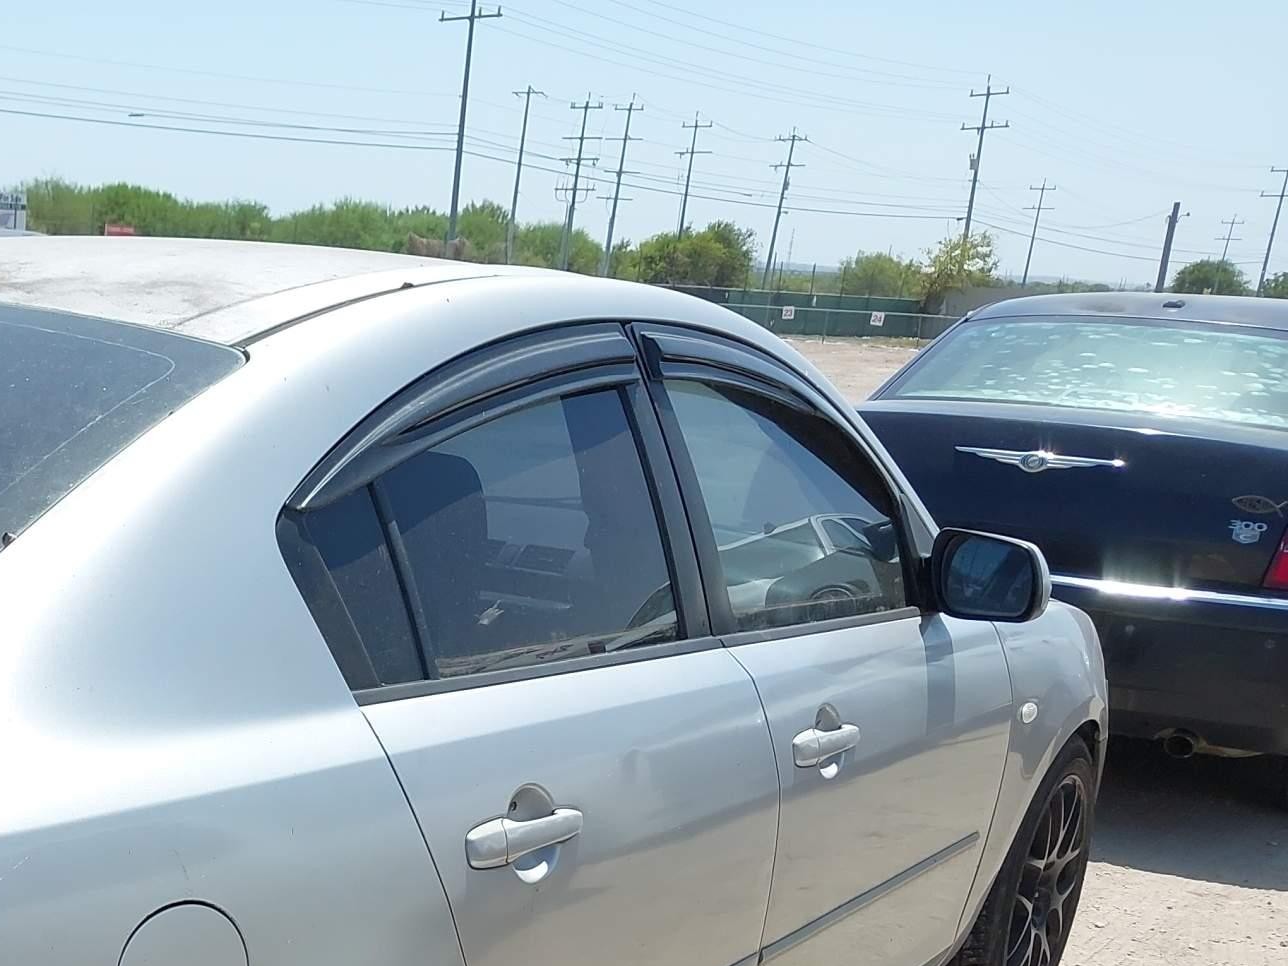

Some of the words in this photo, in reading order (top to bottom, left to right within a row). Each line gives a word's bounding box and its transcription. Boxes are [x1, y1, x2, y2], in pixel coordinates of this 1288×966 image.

[783, 308, 793, 317] 23
[872, 314, 882, 324] 24
[1228, 519, 1268, 532] 300
